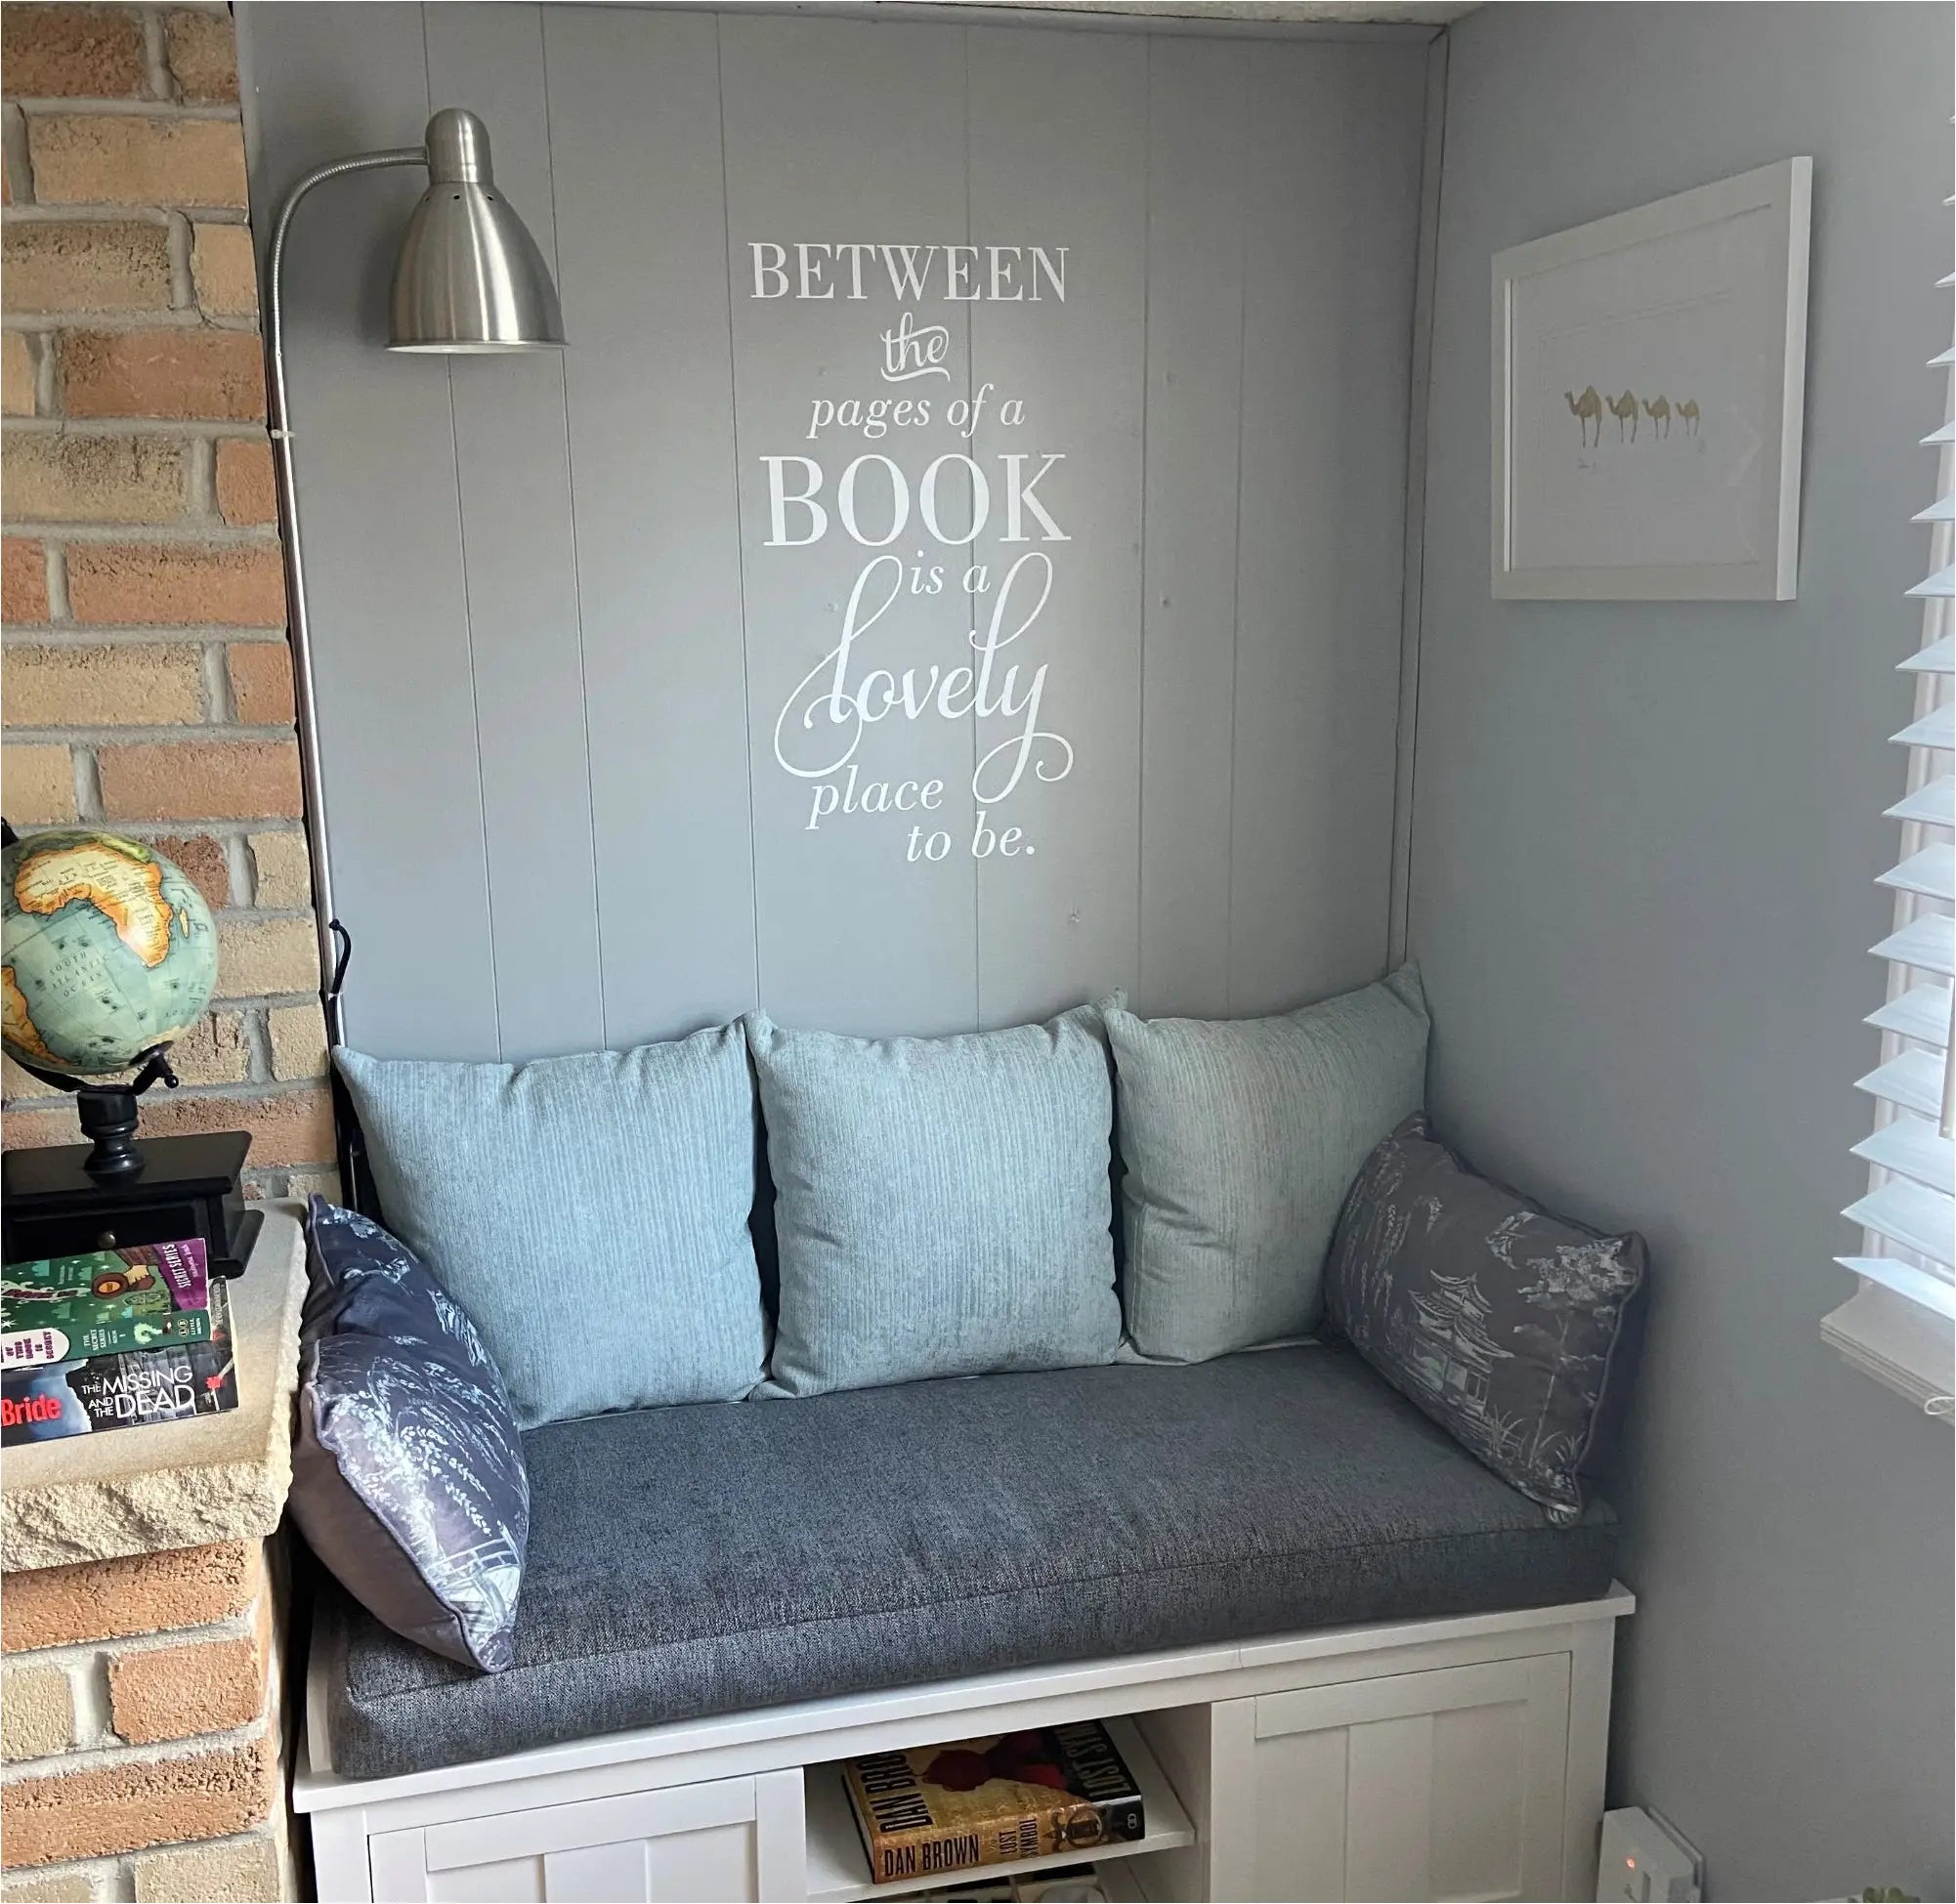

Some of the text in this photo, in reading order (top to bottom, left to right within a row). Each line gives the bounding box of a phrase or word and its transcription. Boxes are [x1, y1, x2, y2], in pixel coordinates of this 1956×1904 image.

[748, 242, 1070, 303] BETWEEN
[880, 312, 951, 382] the
[806, 383, 1026, 440] pages of a
[759, 453, 1072, 547] BOOK
[911, 549, 991, 594] is a
[775, 552, 1074, 804] lovely
[805, 764, 944, 830] place
[907, 811, 1036, 863] to be.
[162, 1244, 183, 1268] SERIES
[172, 1268, 192, 1289] SECRET
[90, 1330, 99, 1351] SECRET
[81, 1366, 193, 1396] THE MISSING
[114, 1384, 197, 1418] DEAD
[88, 1397, 114, 1409] AND
[94, 1407, 114, 1417] THE
[856, 1755, 933, 1833] DAN BRO
[1072, 1758, 1131, 1797] LOST
[884, 1834, 980, 1877] DAN BROWN
[999, 1830, 1017, 1855] LOST
[1019, 1816, 1039, 1858] SYMBOL
